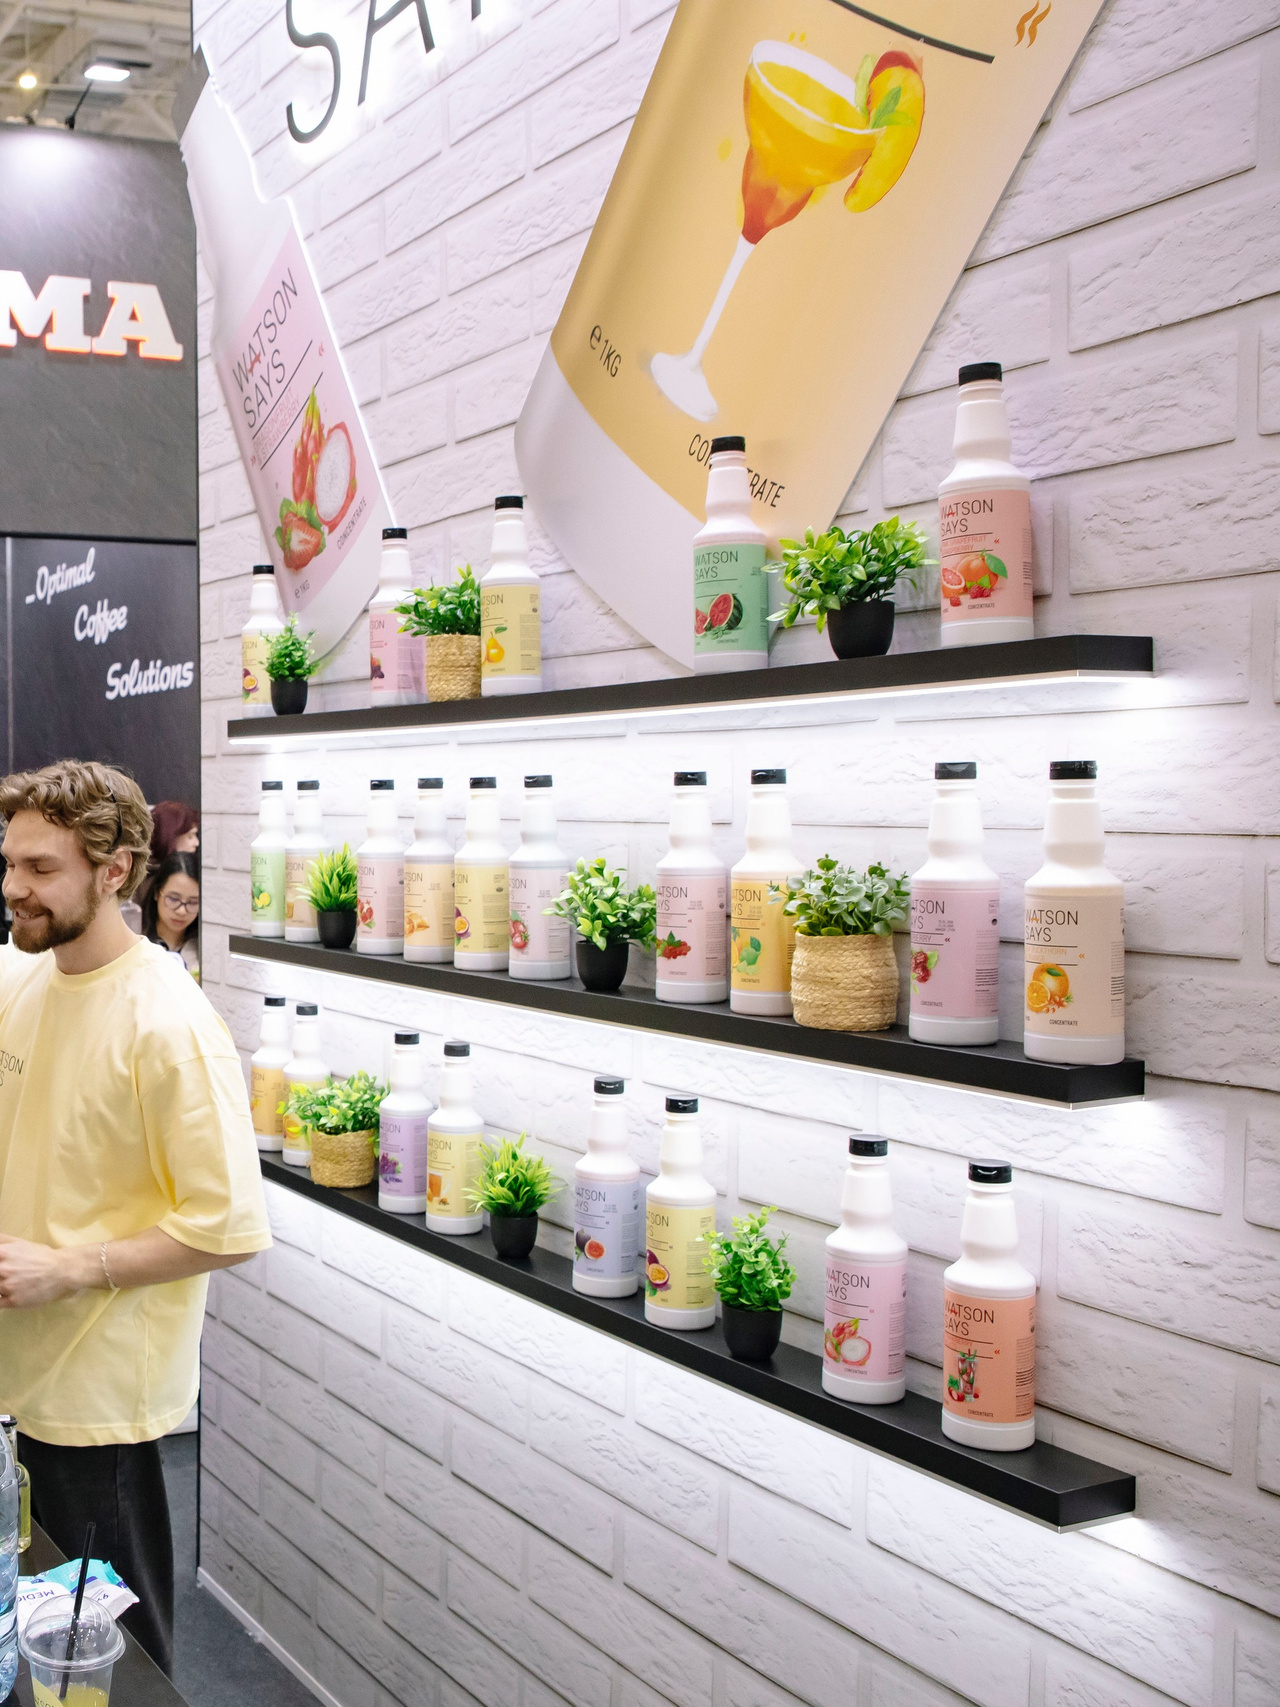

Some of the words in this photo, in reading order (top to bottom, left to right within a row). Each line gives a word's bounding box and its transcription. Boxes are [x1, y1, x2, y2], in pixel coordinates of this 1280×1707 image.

[286, 0, 481, 144] SA
[231, 267, 298, 393] WATSON
[243, 349, 286, 429] SAYS
[74, 598, 128, 645] Coffee
[105, 658, 194, 700] Solutions
